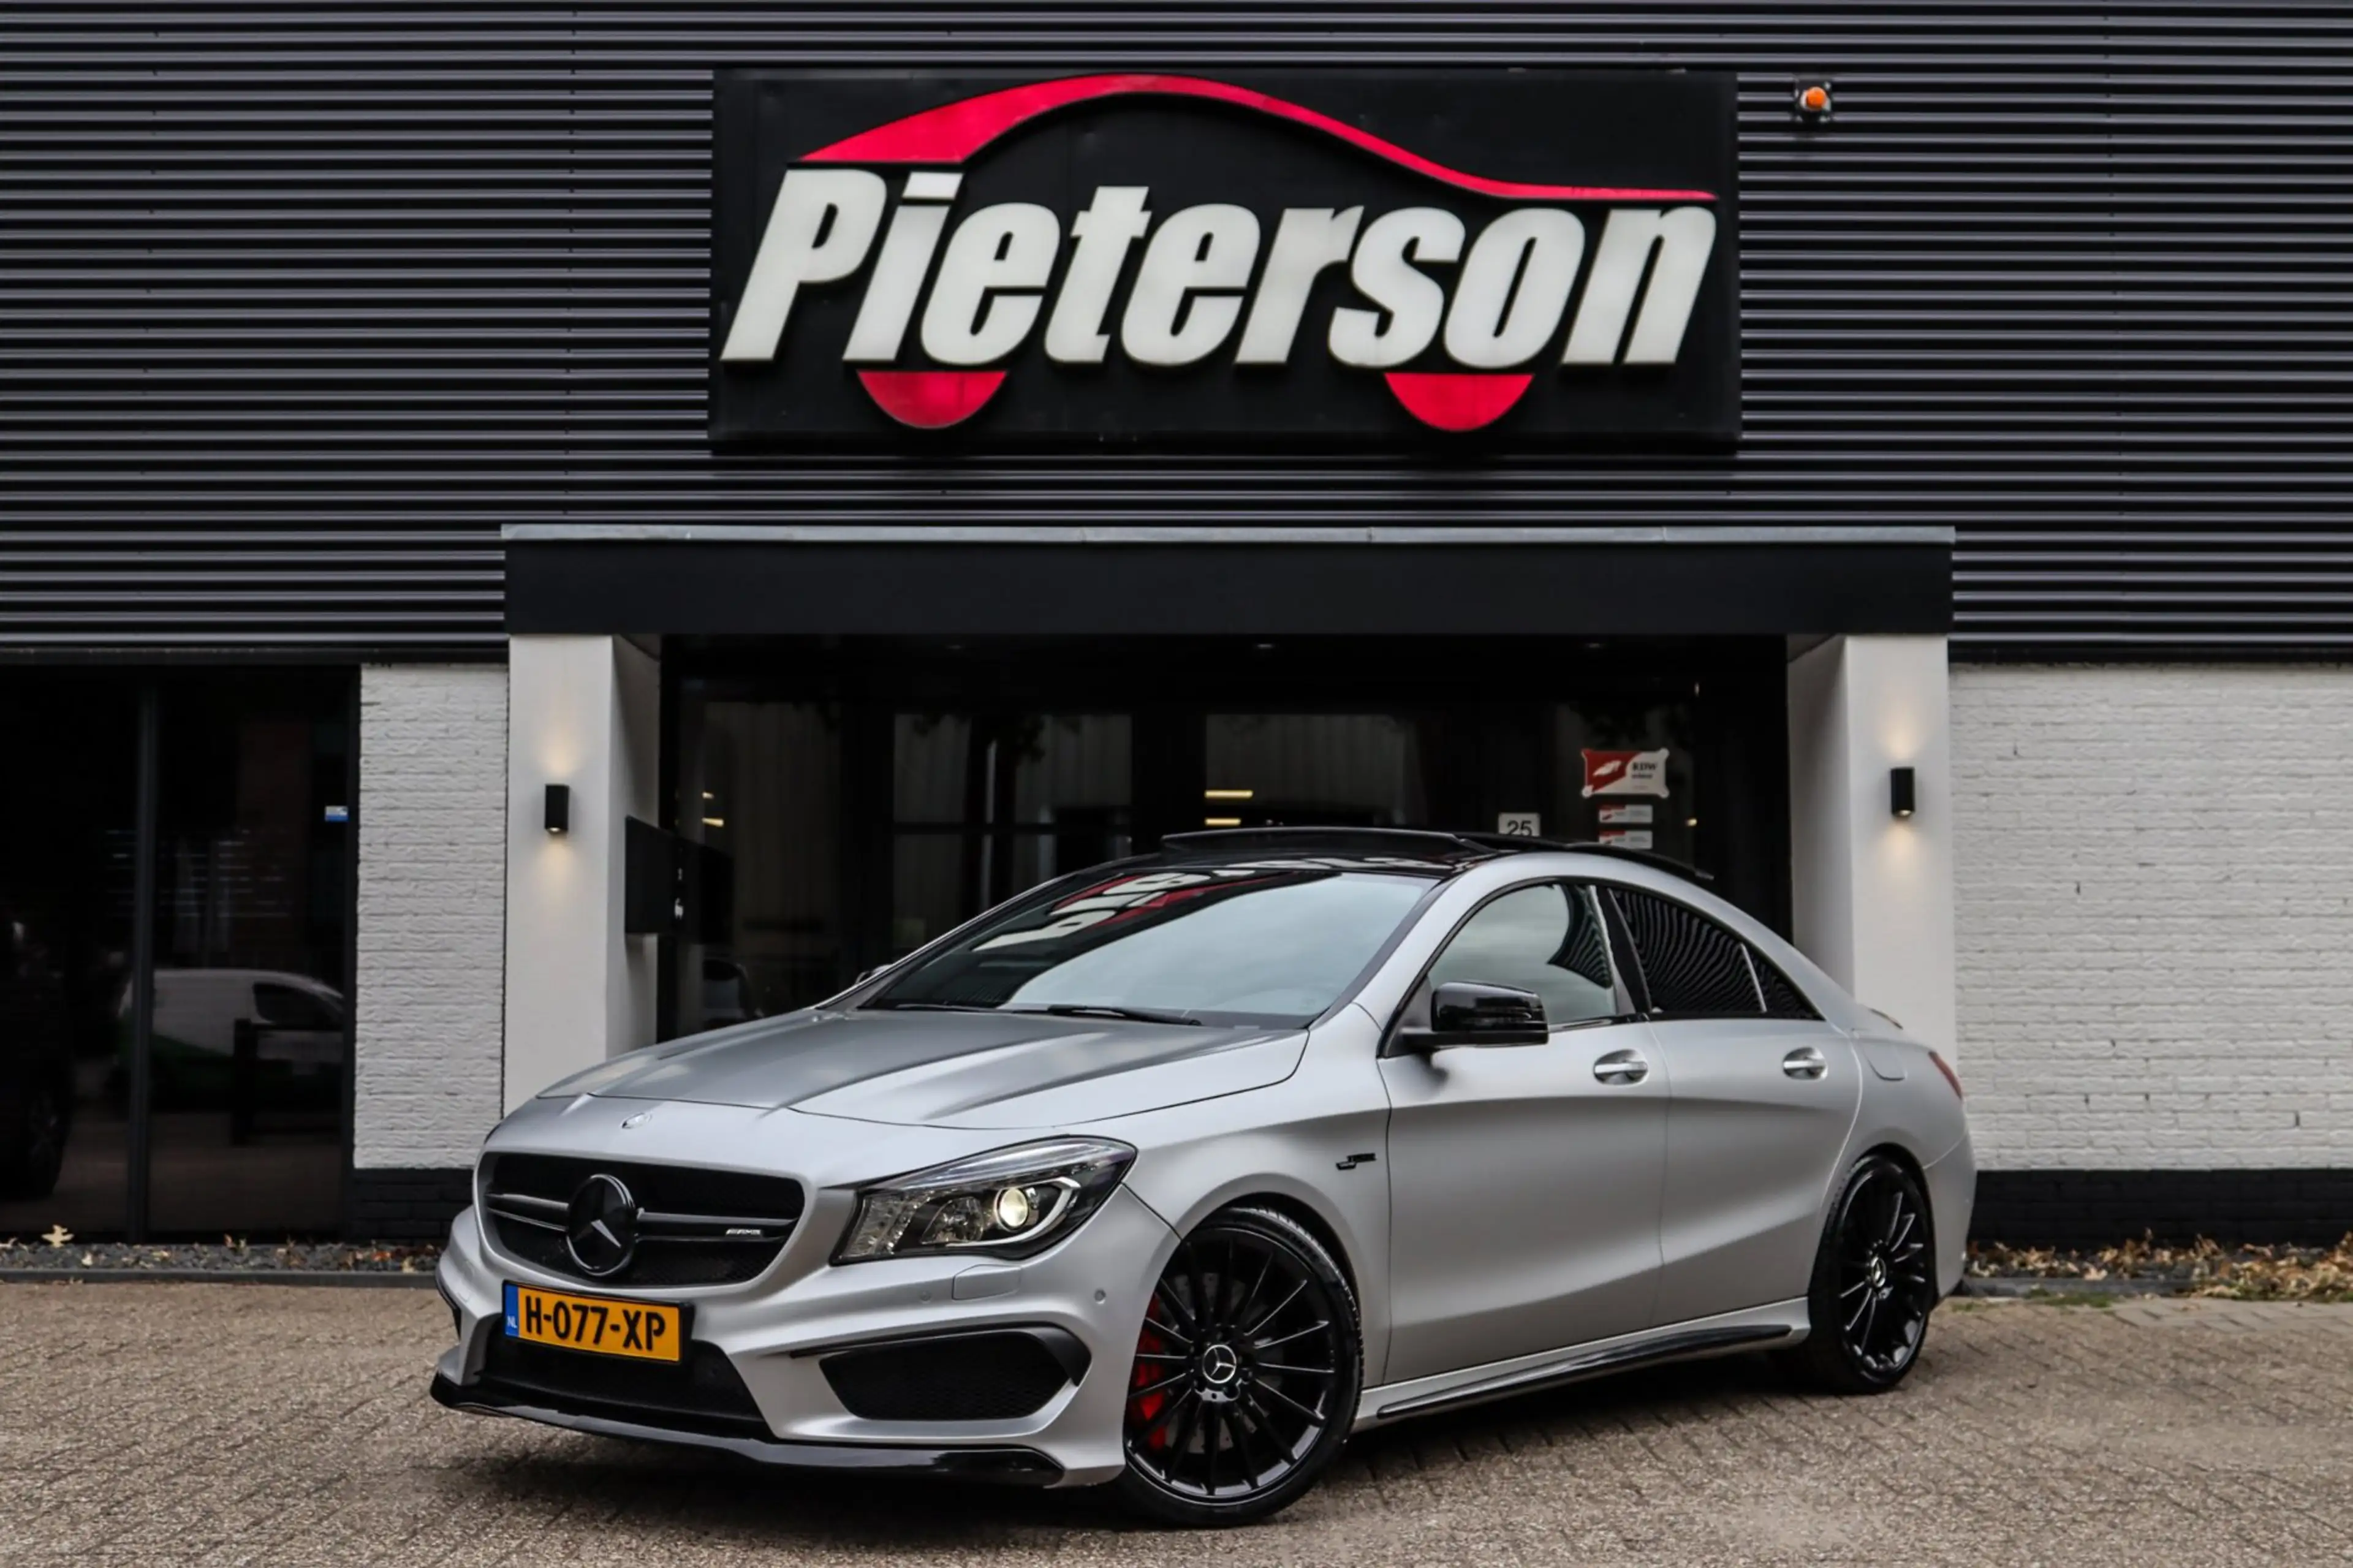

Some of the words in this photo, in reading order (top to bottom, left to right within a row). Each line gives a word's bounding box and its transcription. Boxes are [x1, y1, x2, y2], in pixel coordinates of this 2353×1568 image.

[719, 169, 1717, 368] Pieterson
[1507, 820, 1532, 836] 25
[507, 1315, 518, 1328] NL
[525, 1295, 665, 1351] H-077-XP
